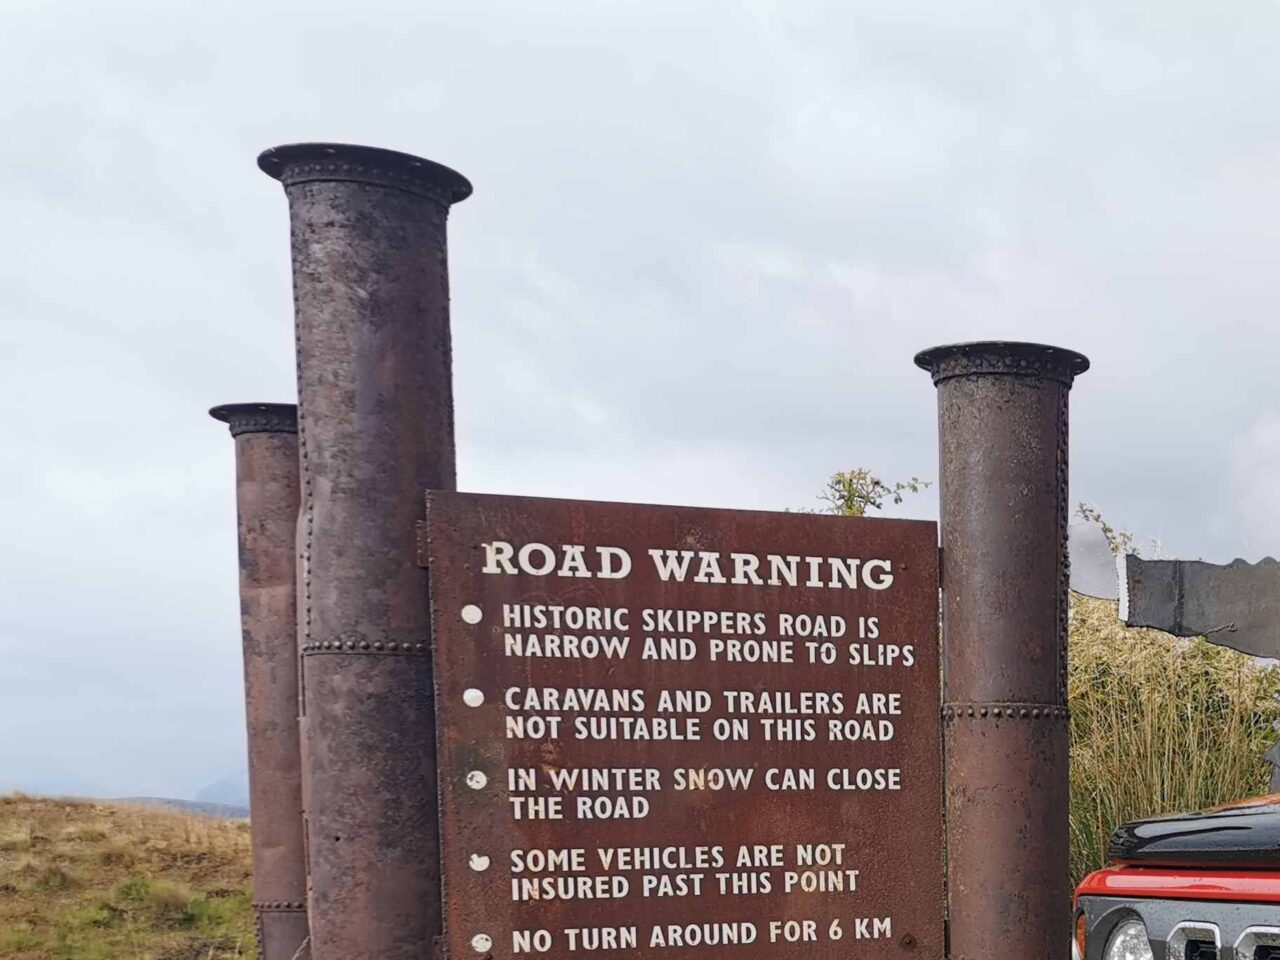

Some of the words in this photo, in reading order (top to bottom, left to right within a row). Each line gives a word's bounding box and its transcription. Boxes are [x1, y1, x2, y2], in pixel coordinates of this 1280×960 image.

[480, 541, 632, 579] ROAD
[647, 548, 894, 591] WARNING
[502, 603, 629, 631] HISTORIC
[642, 608, 766, 635] SKIPPERS
[779, 613, 846, 638] ROAD
[858, 616, 879, 639] IS
[504, 633, 630, 660] NARROW
[641, 637, 697, 661] AND
[709, 639, 794, 663] PRONE
[805, 641, 837, 665] TO
[849, 643, 915, 667] SLIPS
[505, 686, 645, 712] CARAVANS
[657, 690, 712, 713] AND
[723, 690, 844, 715] TRAILERS
[855, 692, 902, 715] ARE
[505, 715, 562, 739] NOT
[574, 716, 701, 741] SUITABLE
[713, 718, 749, 741] ON
[760, 718, 816, 741] THIS
[828, 719, 894, 741] ROAD
[507, 768, 536, 791] IN
[548, 768, 662, 791] WINTER
[673, 768, 754, 791] SNOW
[765, 768, 815, 791] CAN
[826, 768, 901, 790] CLOSE
[508, 796, 563, 820] THE
[576, 796, 650, 819] ROAD
[510, 848, 586, 873] SOME
[597, 845, 724, 871] VEHICLES
[736, 844, 784, 868] ARE
[796, 843, 846, 866] NOT
[511, 875, 629, 901] INSURED
[642, 873, 704, 897] PAST
[715, 871, 772, 895] THIS
[784, 869, 860, 893] POINT
[512, 929, 552, 953] NO
[563, 926, 637, 951] TURN
[649, 922, 757, 948] AROUND
[769, 920, 818, 943] FOR
[828, 918, 843, 941] 6
[854, 917, 892, 940] KM
